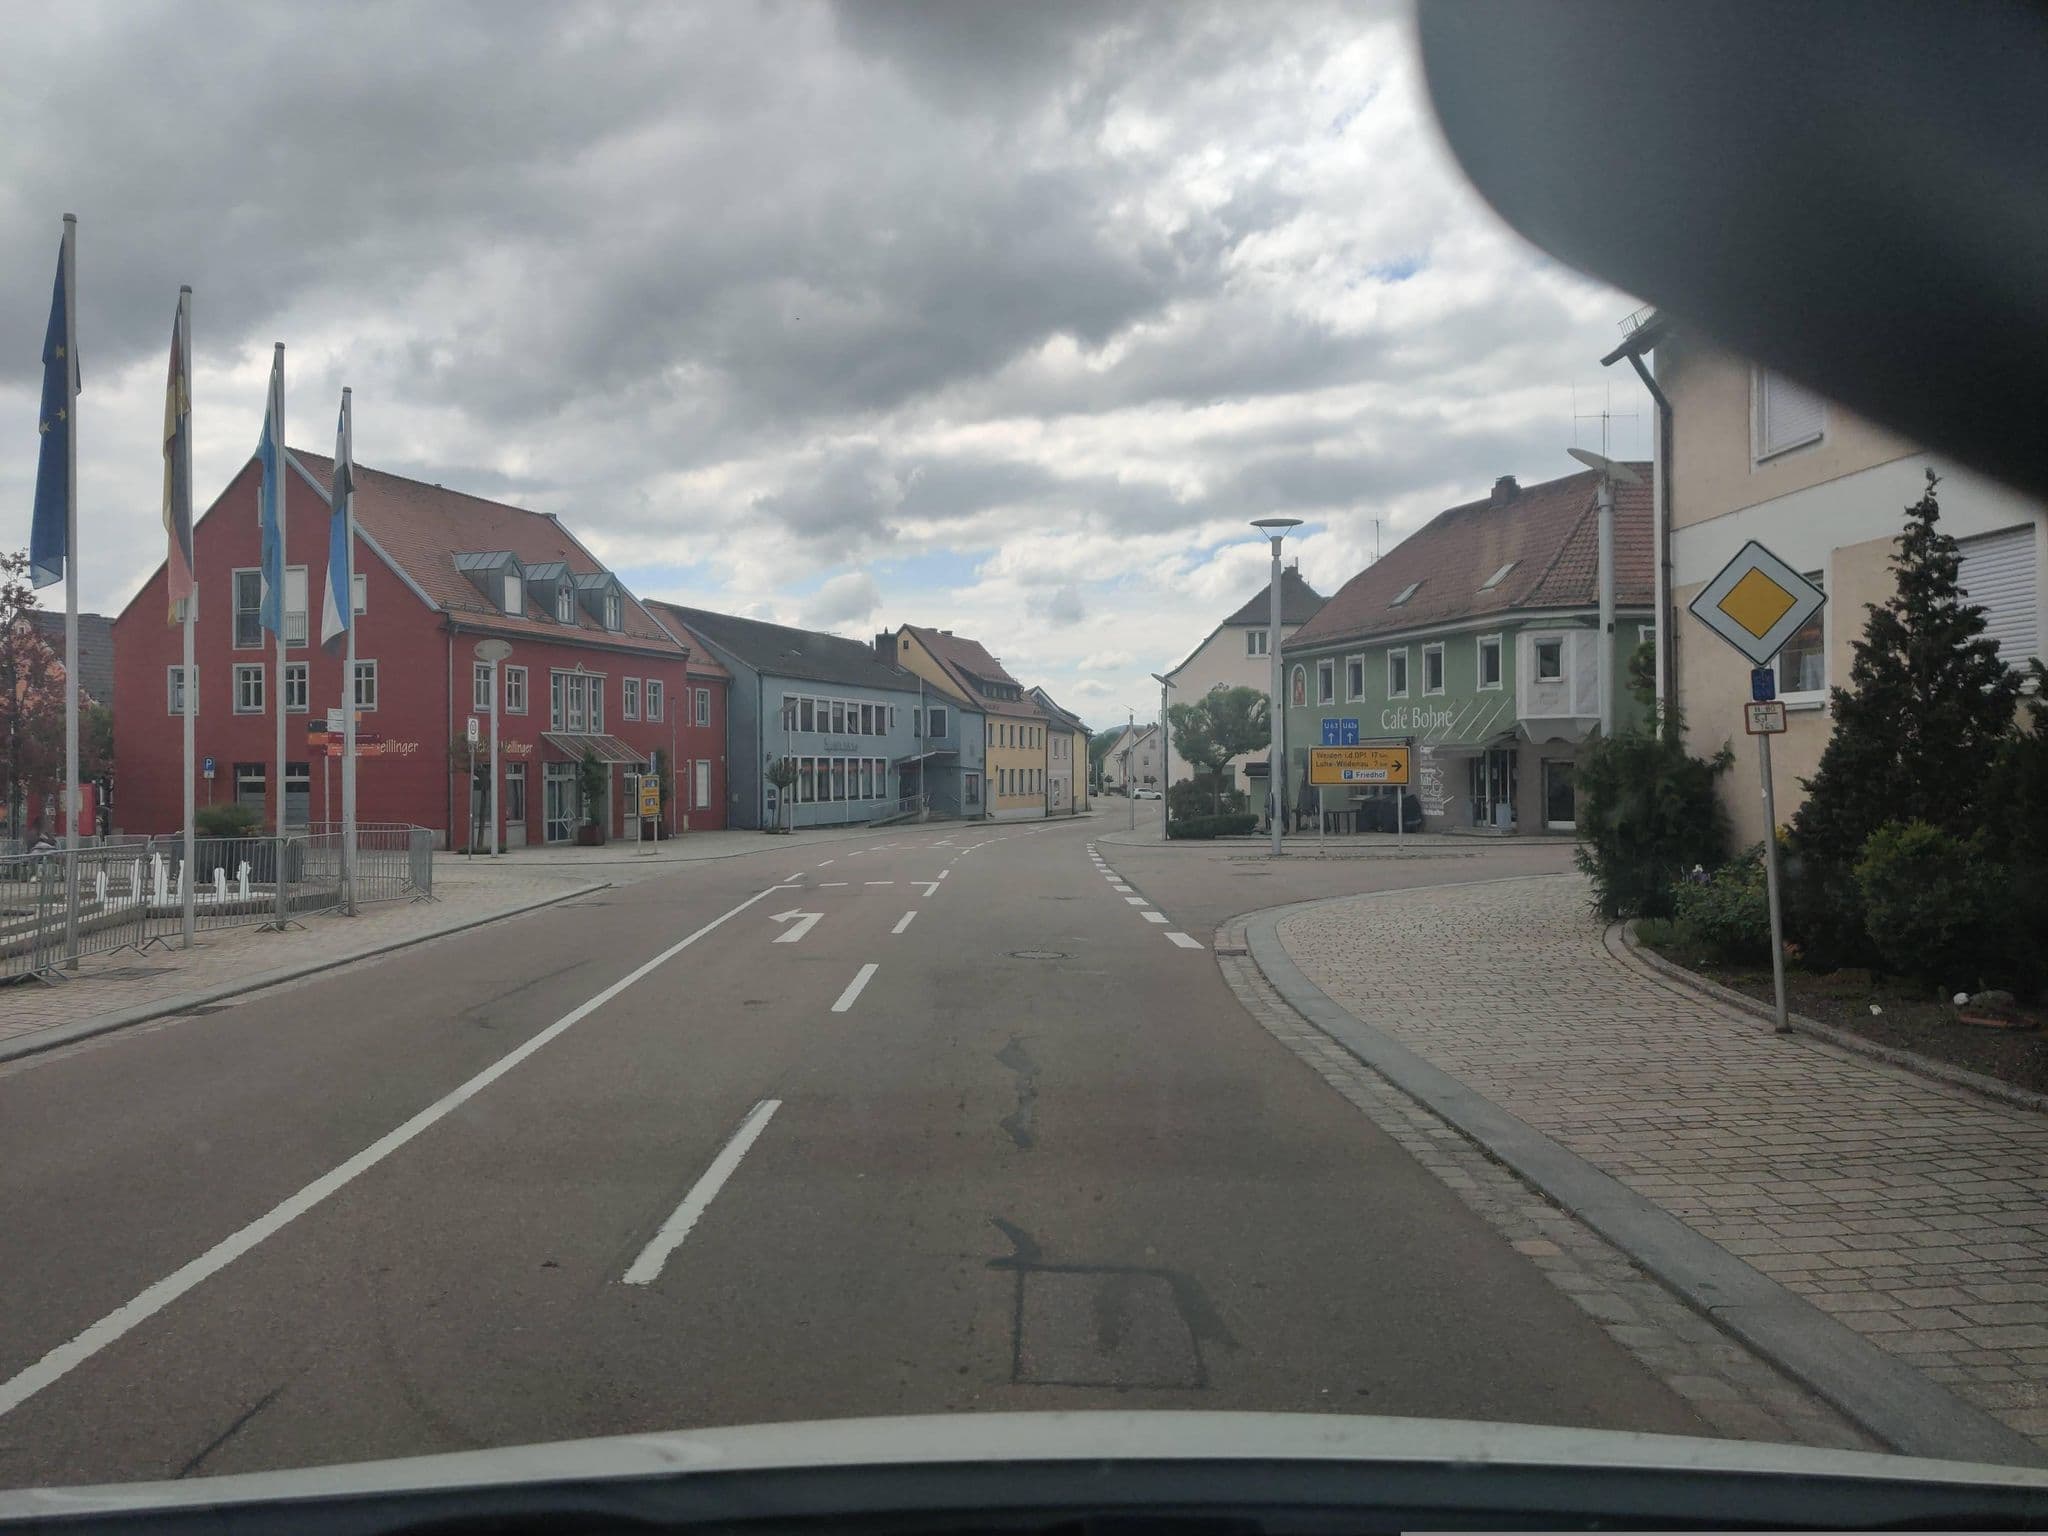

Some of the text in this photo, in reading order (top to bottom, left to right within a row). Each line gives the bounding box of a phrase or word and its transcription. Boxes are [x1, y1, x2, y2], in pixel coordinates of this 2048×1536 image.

[1381, 704, 1453, 730] Café Bohne
[380, 739, 419, 757] eillinger
[206, 758, 213, 770] P
